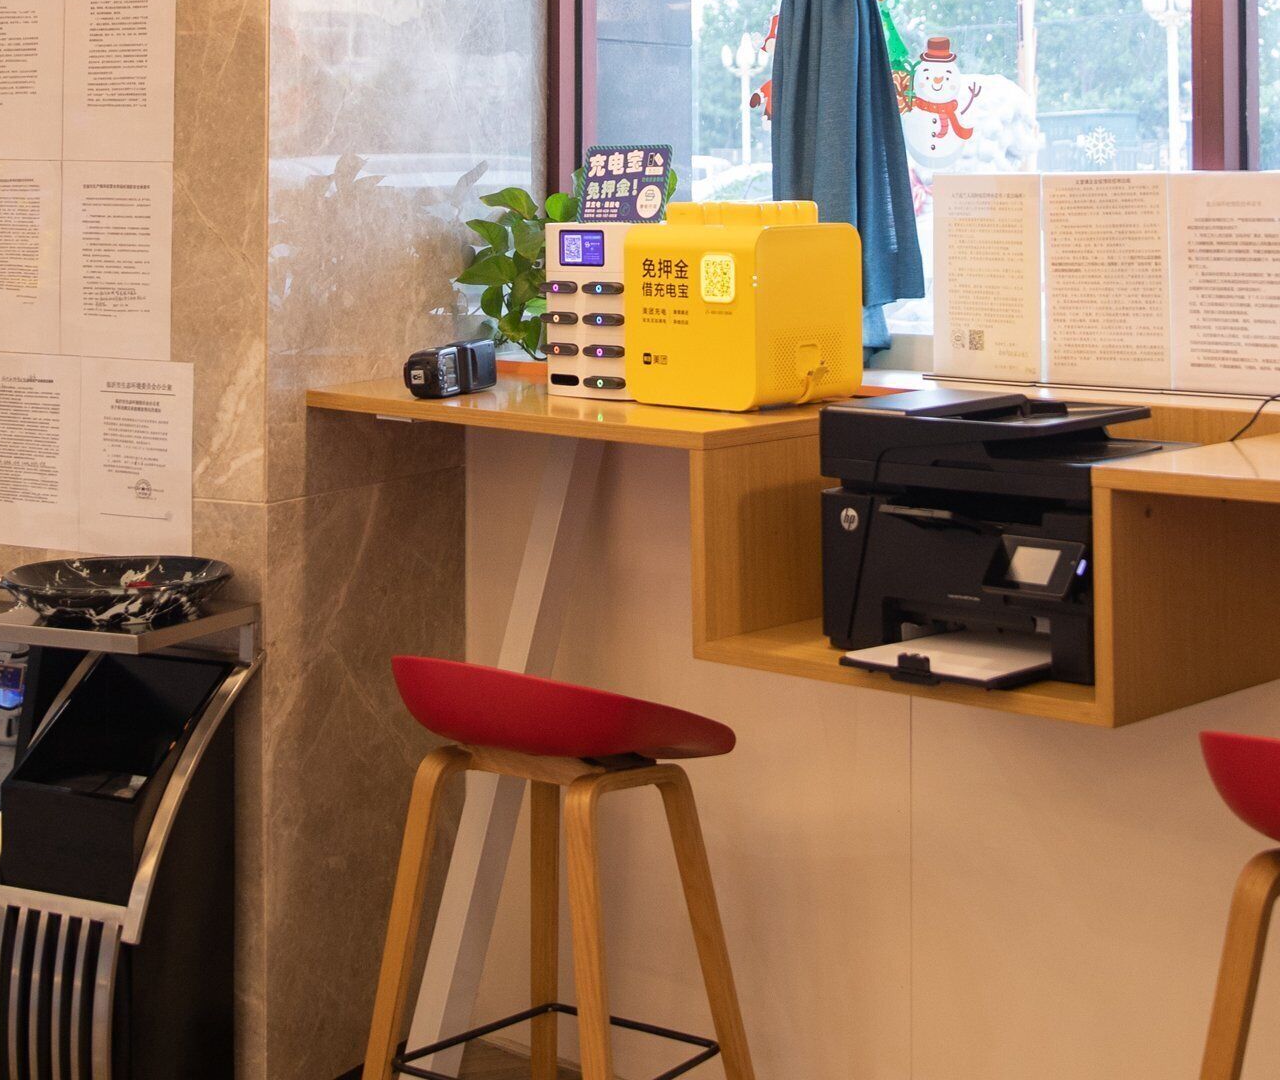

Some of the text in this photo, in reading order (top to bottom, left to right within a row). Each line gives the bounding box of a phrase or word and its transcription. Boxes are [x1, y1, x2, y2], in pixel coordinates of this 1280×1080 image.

[588, 149, 645, 178] 充电宝
[641, 257, 689, 280] 免押金
[641, 281, 689, 299] 借充电宝
